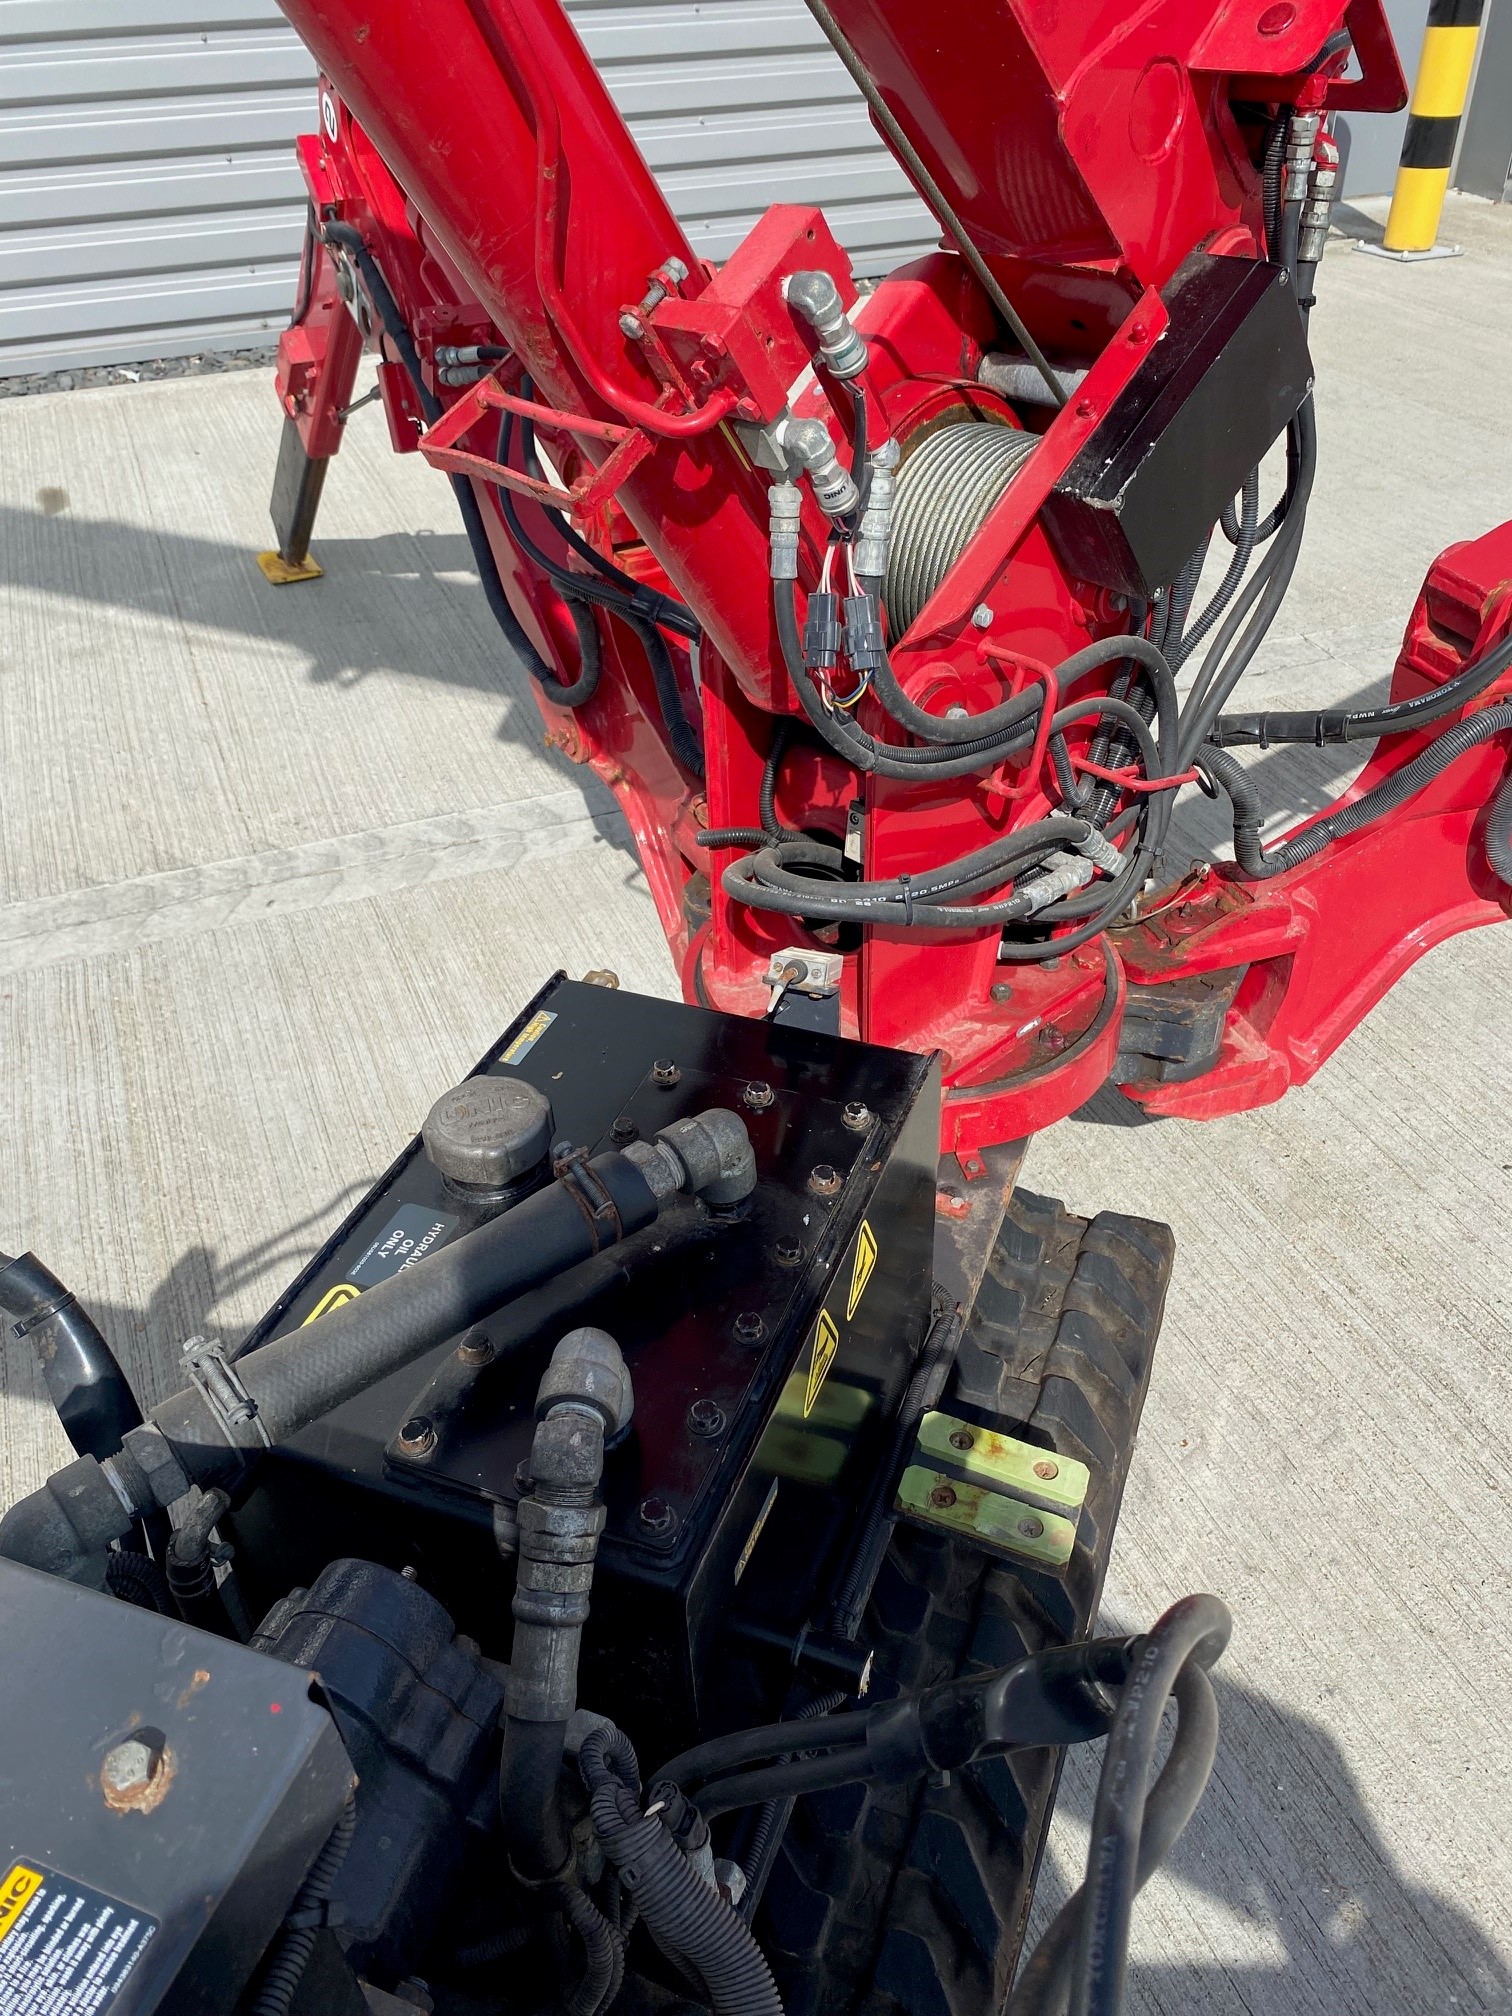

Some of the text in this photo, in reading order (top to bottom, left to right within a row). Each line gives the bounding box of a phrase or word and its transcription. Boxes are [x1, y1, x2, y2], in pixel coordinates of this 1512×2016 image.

[822, 484, 847, 501] UNIC
[377, 1229, 405, 1258] ONLY
[394, 1239, 414, 1255] OIL
[398, 1222, 445, 1273] HYDRAUL
